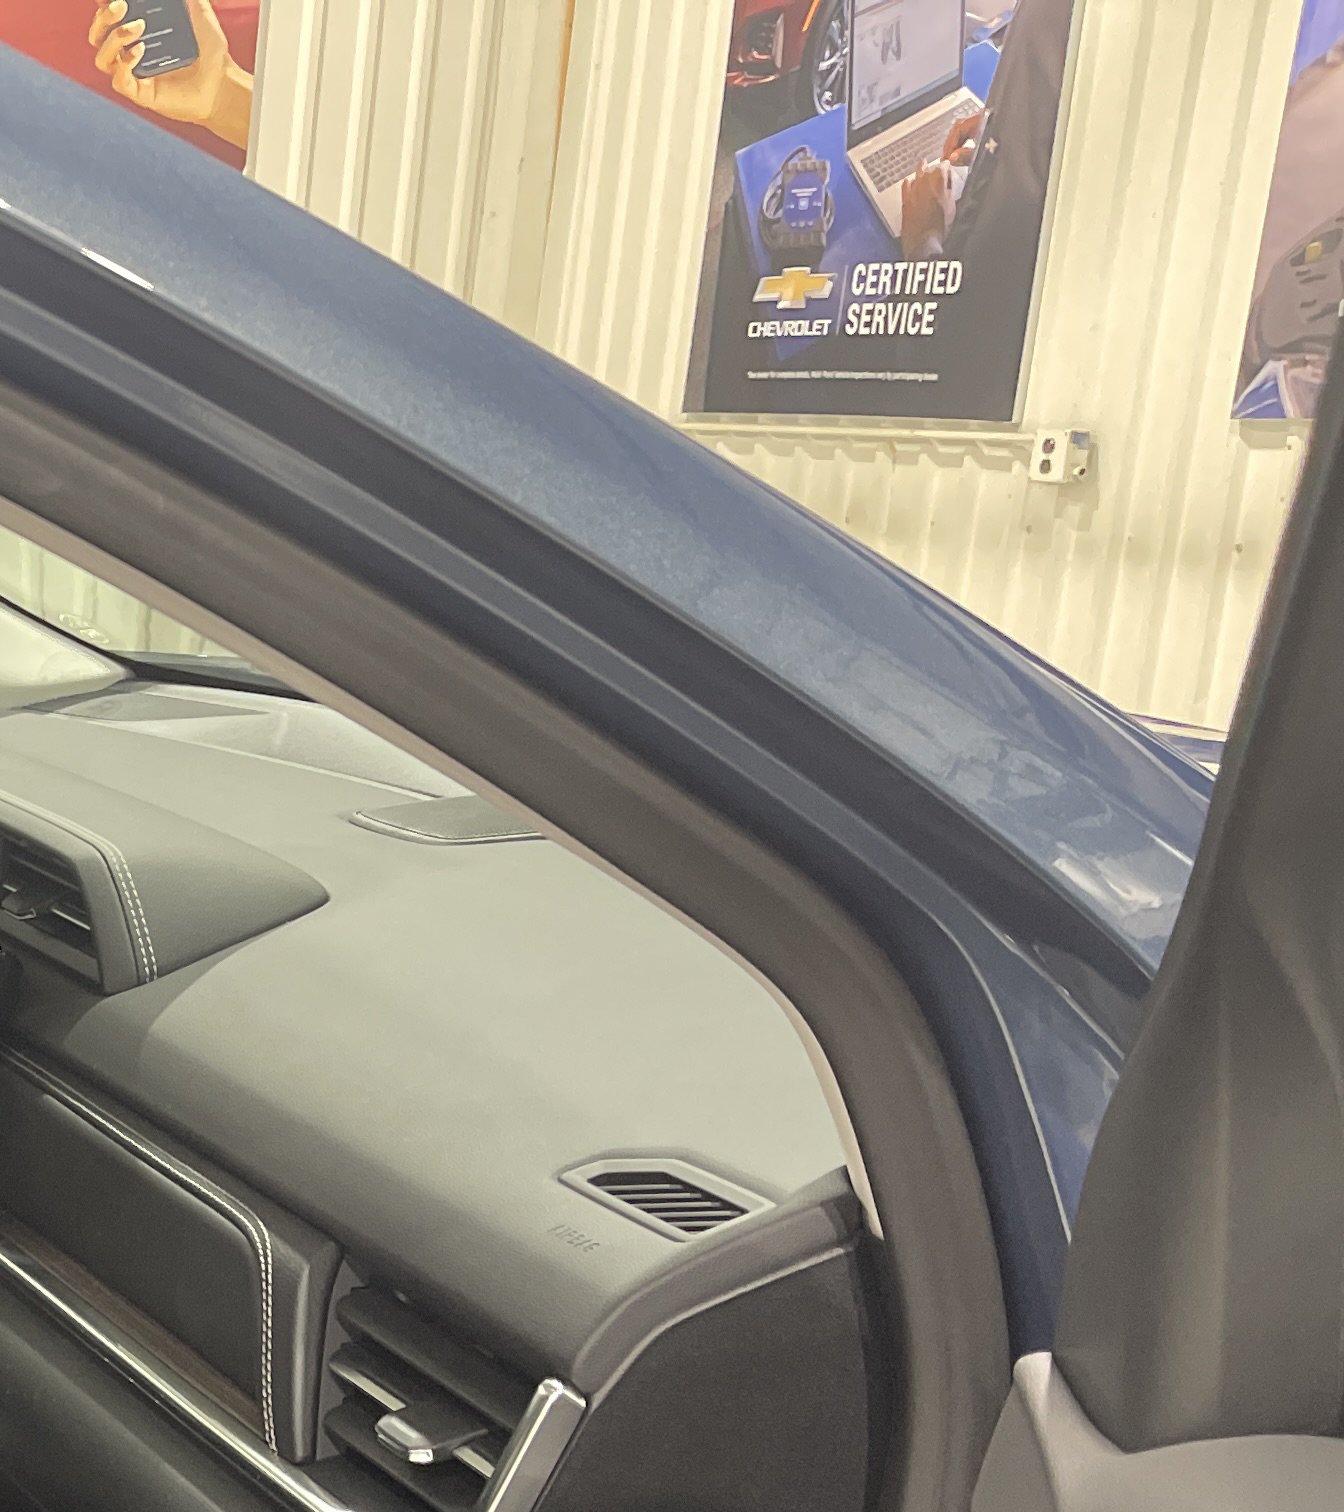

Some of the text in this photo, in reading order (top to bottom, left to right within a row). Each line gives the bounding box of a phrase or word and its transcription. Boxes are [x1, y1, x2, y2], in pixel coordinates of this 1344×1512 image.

[851, 260, 963, 296] CERTIFIED
[747, 319, 832, 338] CHEVROLET
[845, 302, 938, 335] SERVICE
